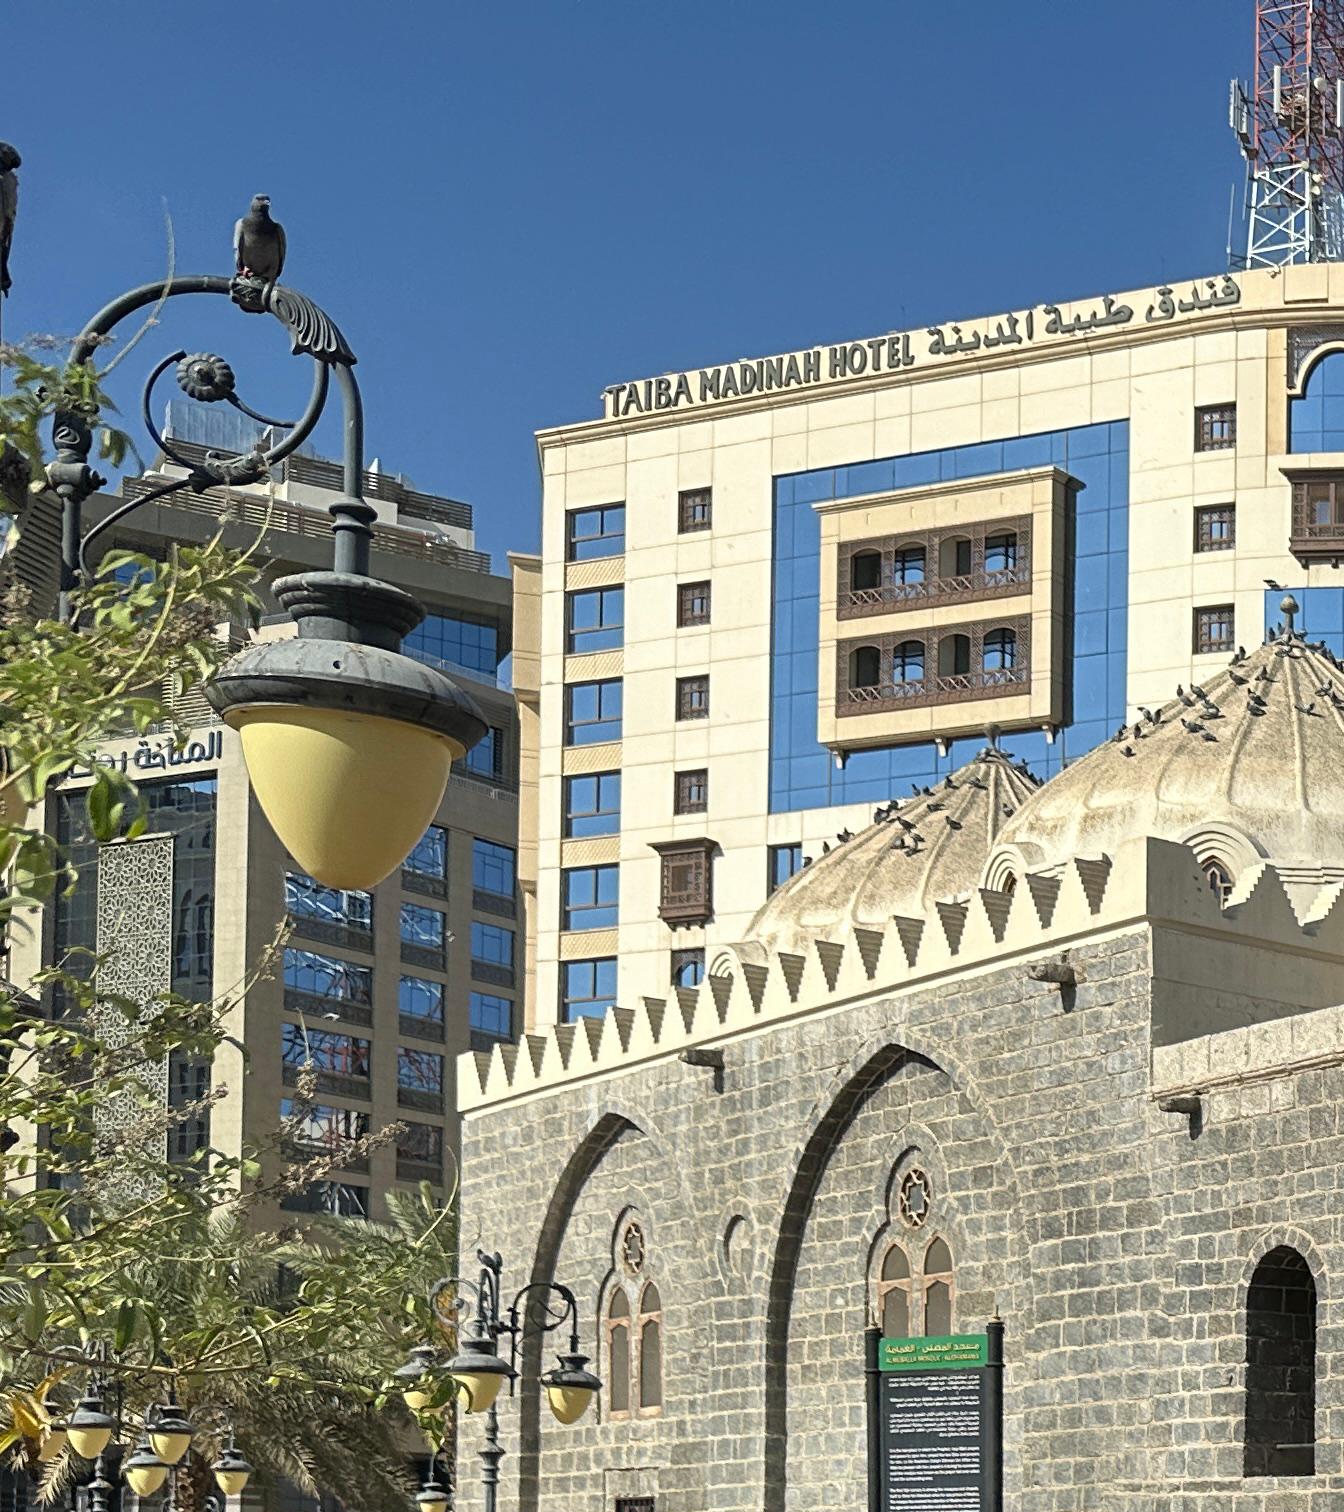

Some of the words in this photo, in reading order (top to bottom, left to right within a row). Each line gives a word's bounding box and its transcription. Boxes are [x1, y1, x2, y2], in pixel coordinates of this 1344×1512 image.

[1045, 295, 1134, 337] طيبة
[1146, 275, 1242, 324] فندق
[928, 309, 1035, 356] المدينة
[605, 370, 694, 417] TAIBA
[699, 350, 822, 402] MADINAH
[829, 334, 915, 378] HOTEL
